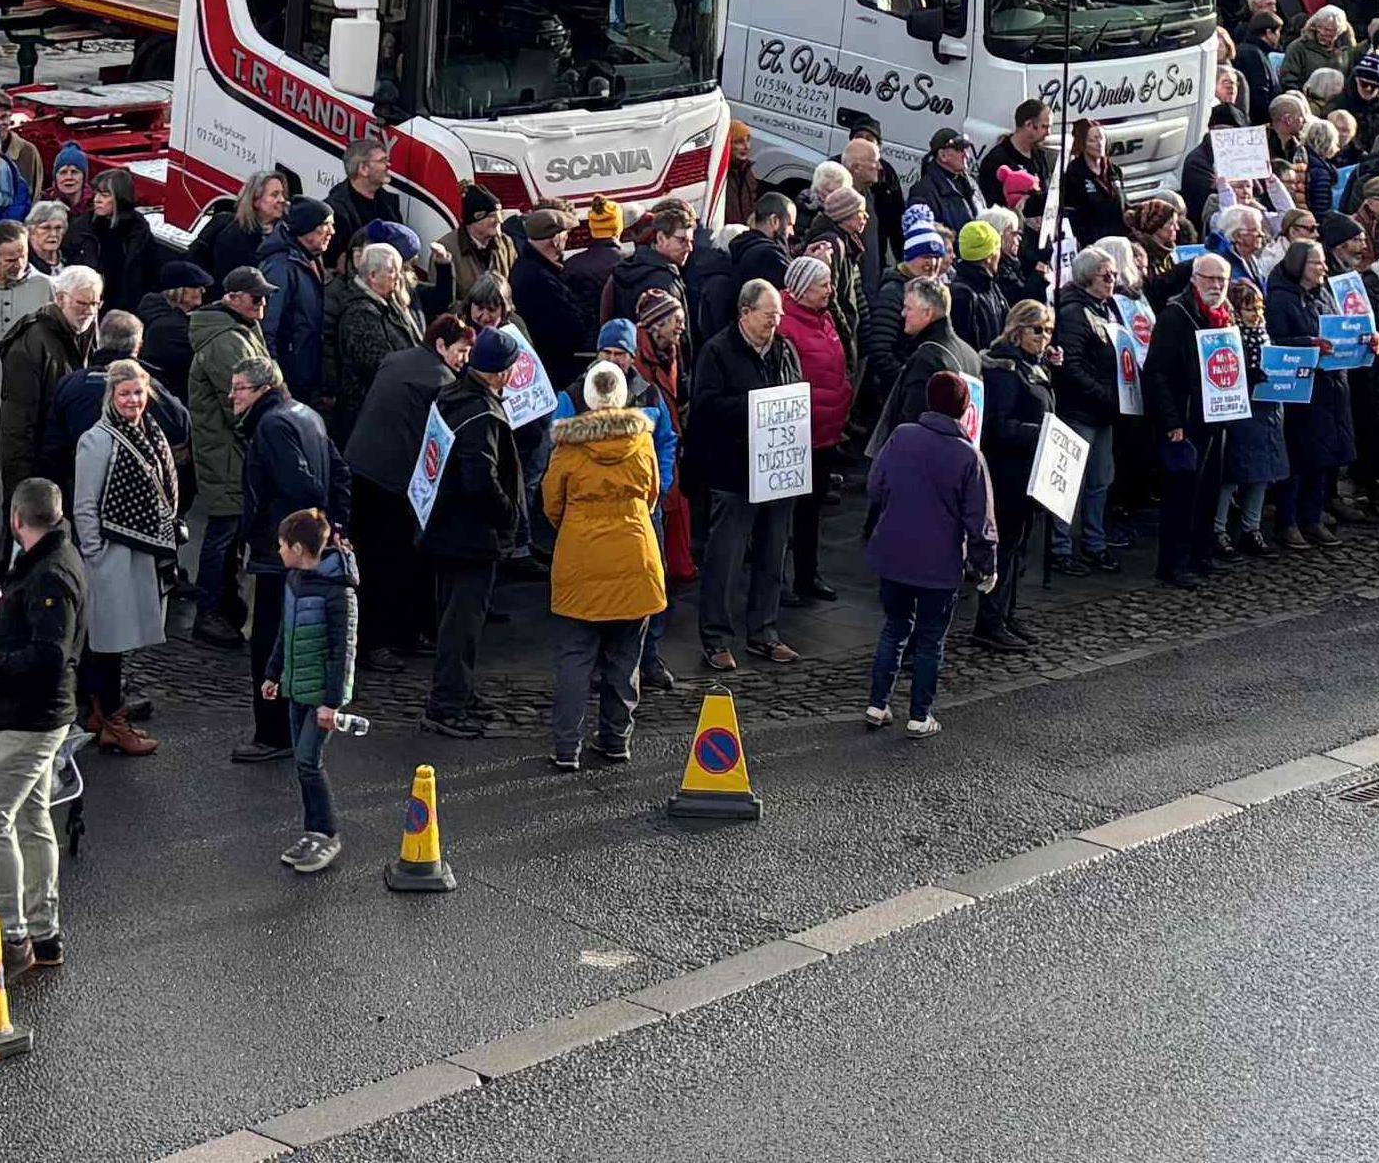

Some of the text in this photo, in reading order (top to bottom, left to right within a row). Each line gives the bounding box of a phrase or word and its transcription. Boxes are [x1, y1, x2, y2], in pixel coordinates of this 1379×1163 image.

[790, 44, 871, 96] Winder
[875, 70, 900, 102] &
[901, 73, 954, 115] Son
[1066, 75, 1135, 113] Winder
[1138, 69, 1157, 103] &
[1158, 64, 1193, 102] Son
[282, 75, 398, 154] HANDLEY
[545, 148, 652, 183] SCANIA
[1109, 138, 1143, 156] AF
[769, 468, 806, 491] OPEN
